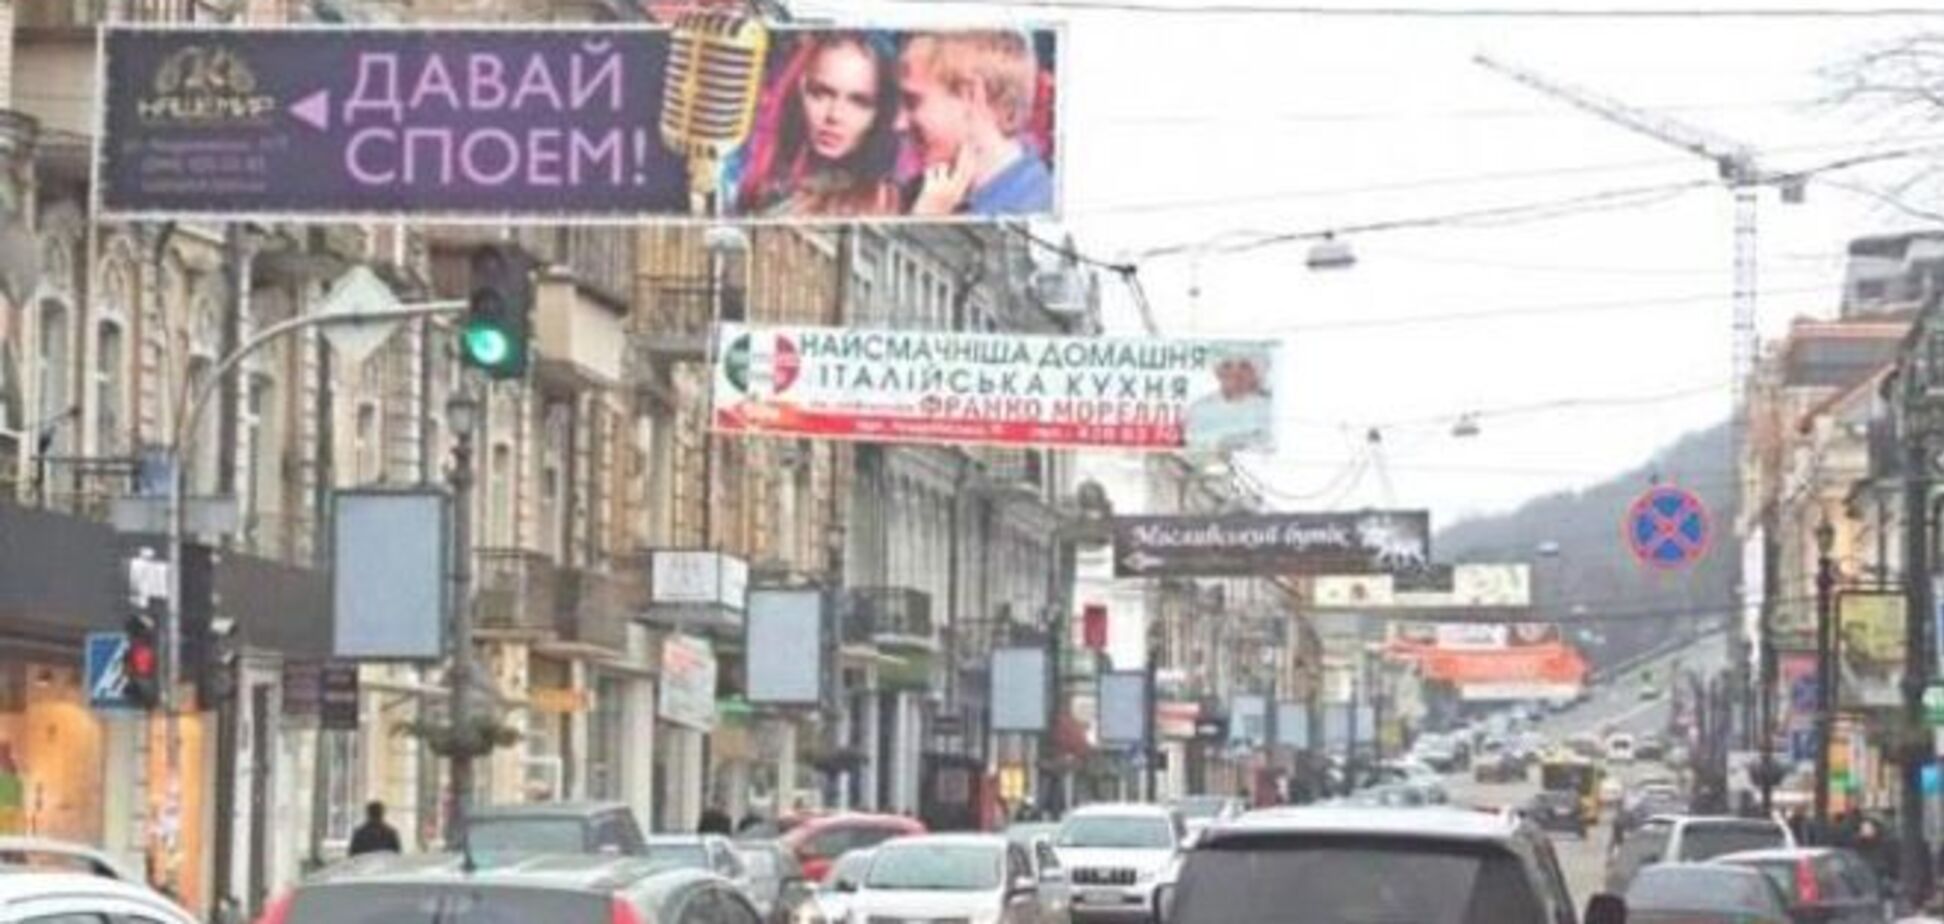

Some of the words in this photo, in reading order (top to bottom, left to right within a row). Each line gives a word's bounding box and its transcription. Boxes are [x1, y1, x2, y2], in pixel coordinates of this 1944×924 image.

[344, 41, 623, 122] ДАВАЙ
[345, 127, 646, 184] СПОЕМ!
[800, 332, 1030, 364] НАЙСМАЧНІША
[1038, 341, 1206, 369] ДОМАШНЯ
[819, 362, 1046, 395] ІТАЛІЙСЬКА
[1067, 370, 1188, 400] КУХНЯ
[920, 394, 1042, 421] ФРАНКО
